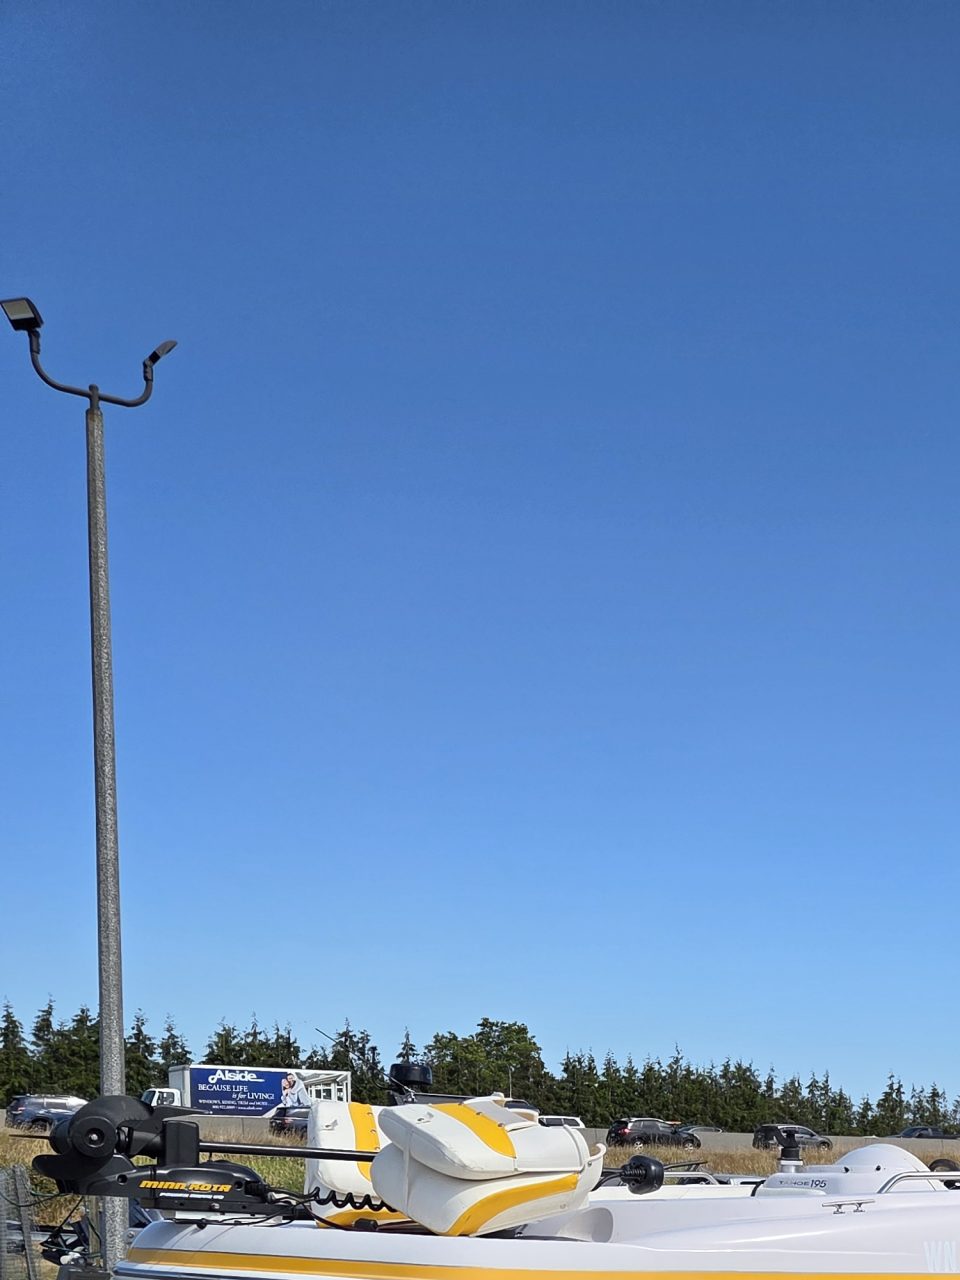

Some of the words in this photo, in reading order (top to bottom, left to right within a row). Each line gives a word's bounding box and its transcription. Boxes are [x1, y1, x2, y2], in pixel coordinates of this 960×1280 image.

[208, 1069, 265, 1084] Alside
[198, 1084, 231, 1092] BECAUSE
[237, 1092, 246, 1100] for
[810, 1179, 827, 1188] 195
[923, 1240, 957, 1272] WN
